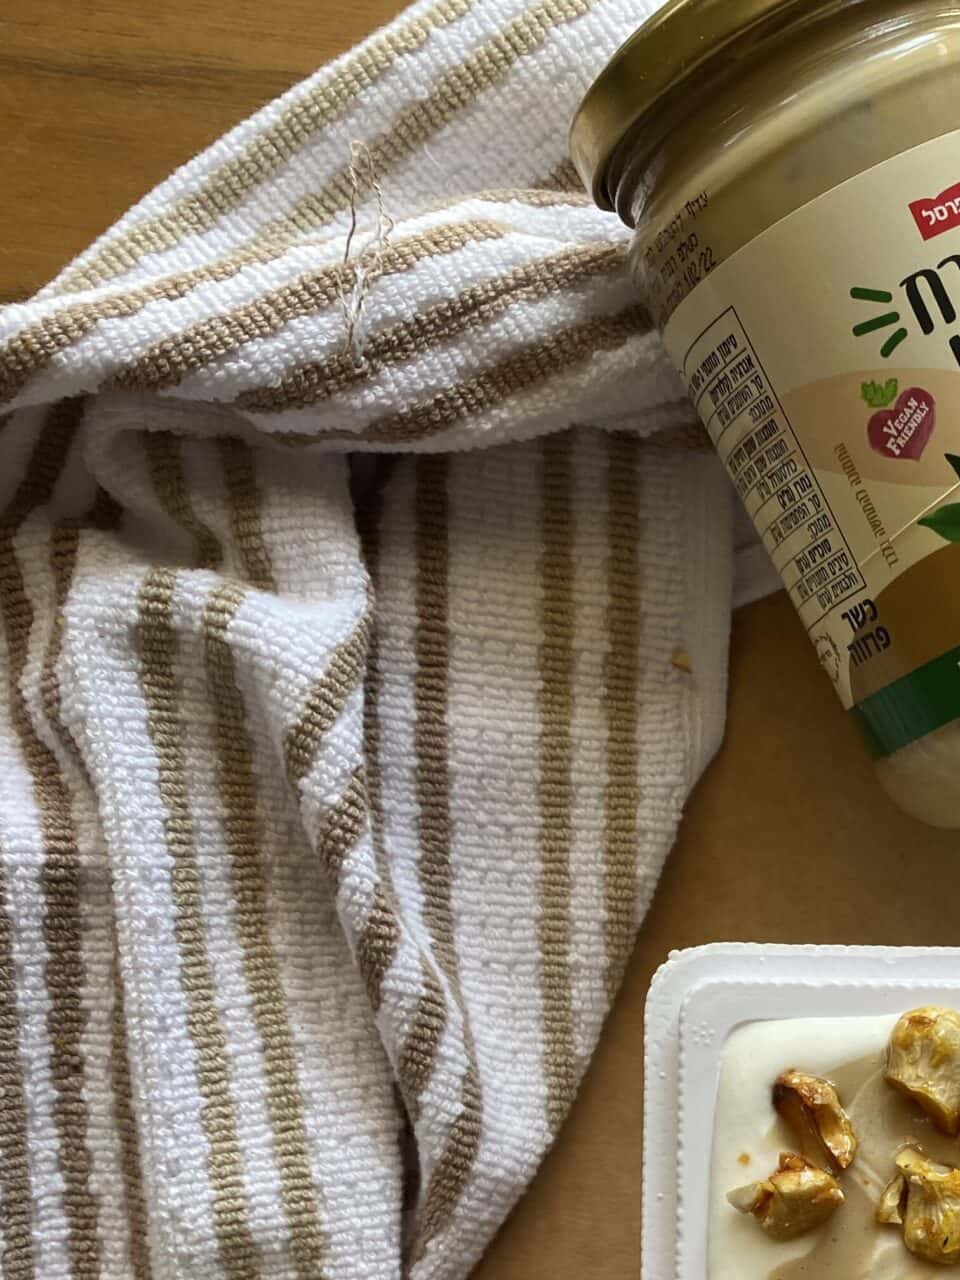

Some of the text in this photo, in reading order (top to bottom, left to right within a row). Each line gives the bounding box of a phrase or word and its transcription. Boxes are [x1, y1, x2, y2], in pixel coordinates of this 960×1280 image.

[883, 397, 919, 437] VEGAN
[885, 401, 930, 457] FRIENDLY
[841, 598, 878, 633] כשר
